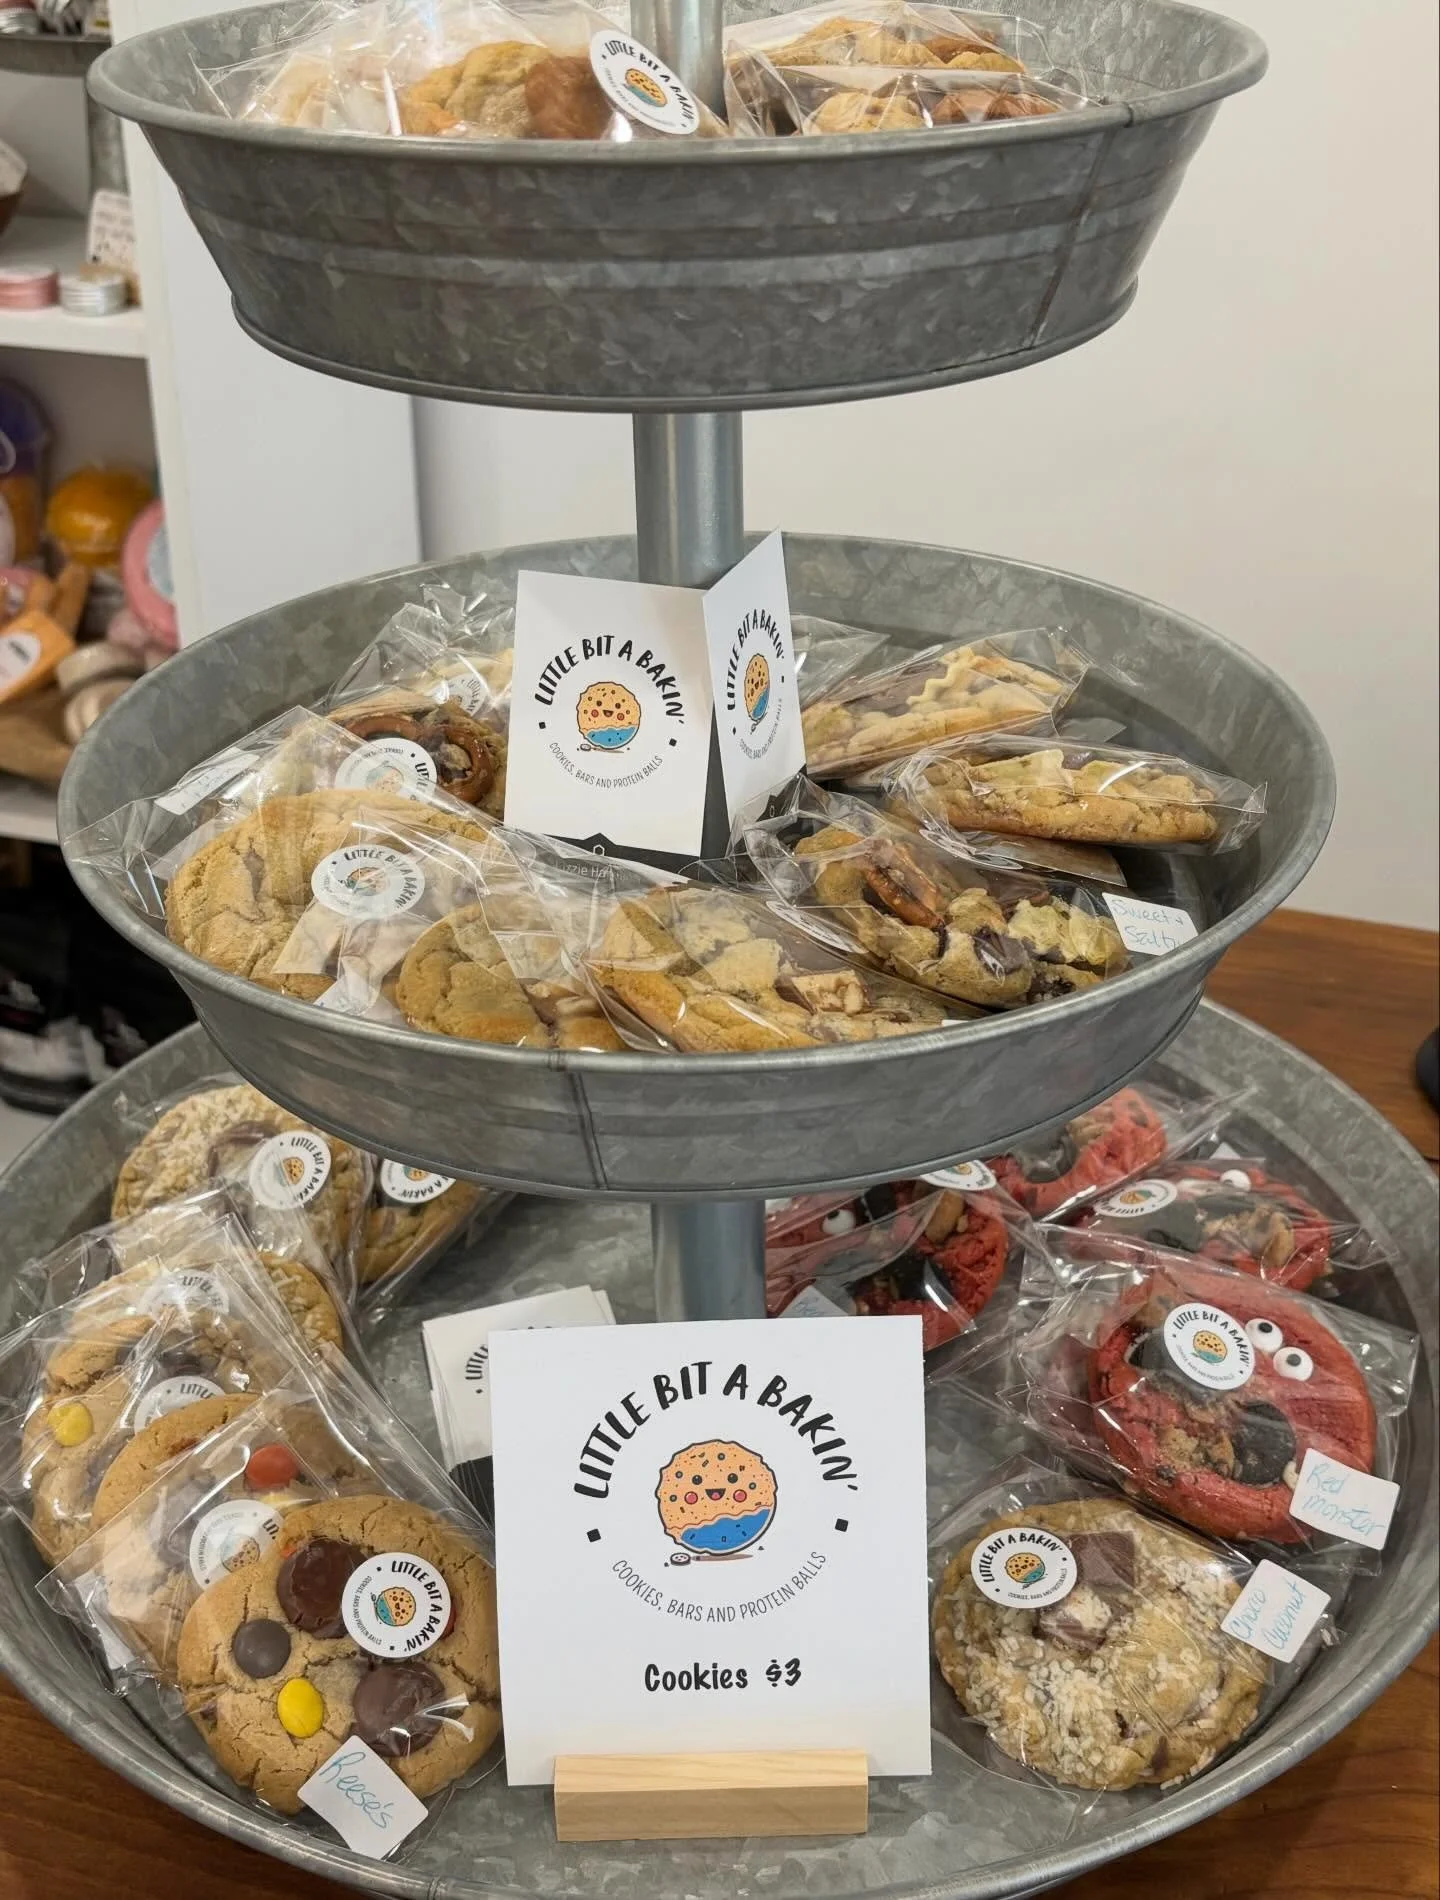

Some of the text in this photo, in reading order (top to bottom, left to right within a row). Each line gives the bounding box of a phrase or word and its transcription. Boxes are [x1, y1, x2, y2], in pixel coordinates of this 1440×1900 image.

[605, 40, 636, 57] LITTLE
[534, 634, 685, 724] LITTLE BIT A BAKIN'
[727, 643, 741, 711] LITTLE
[737, 612, 750, 649] BIT
[752, 608, 758, 630] A
[549, 742, 664, 788] COOKIES, BARS AND PROTEIN BALLS
[344, 849, 384, 861] LITTLE
[291, 1136, 319, 1153] LITTLE
[1173, 1310, 1200, 1330] LITTLE
[1202, 1311, 1219, 1323] BIT
[1220, 1321, 1229, 1330] A
[573, 1361, 858, 1499] LITTLE BIT A BAKIN'
[1307, 1463, 1351, 1493] Red
[979, 1532, 1064, 1583] LITTLE BIT A BAKIN'
[391, 1560, 443, 1653] LITTLE BIT A BAKIN'
[612, 1551, 827, 1623] COOKIES, BARS AND PROTEIN BALLS
[644, 1657, 802, 1691] Cookies $3
[319, 1751, 394, 1829] Reese's
